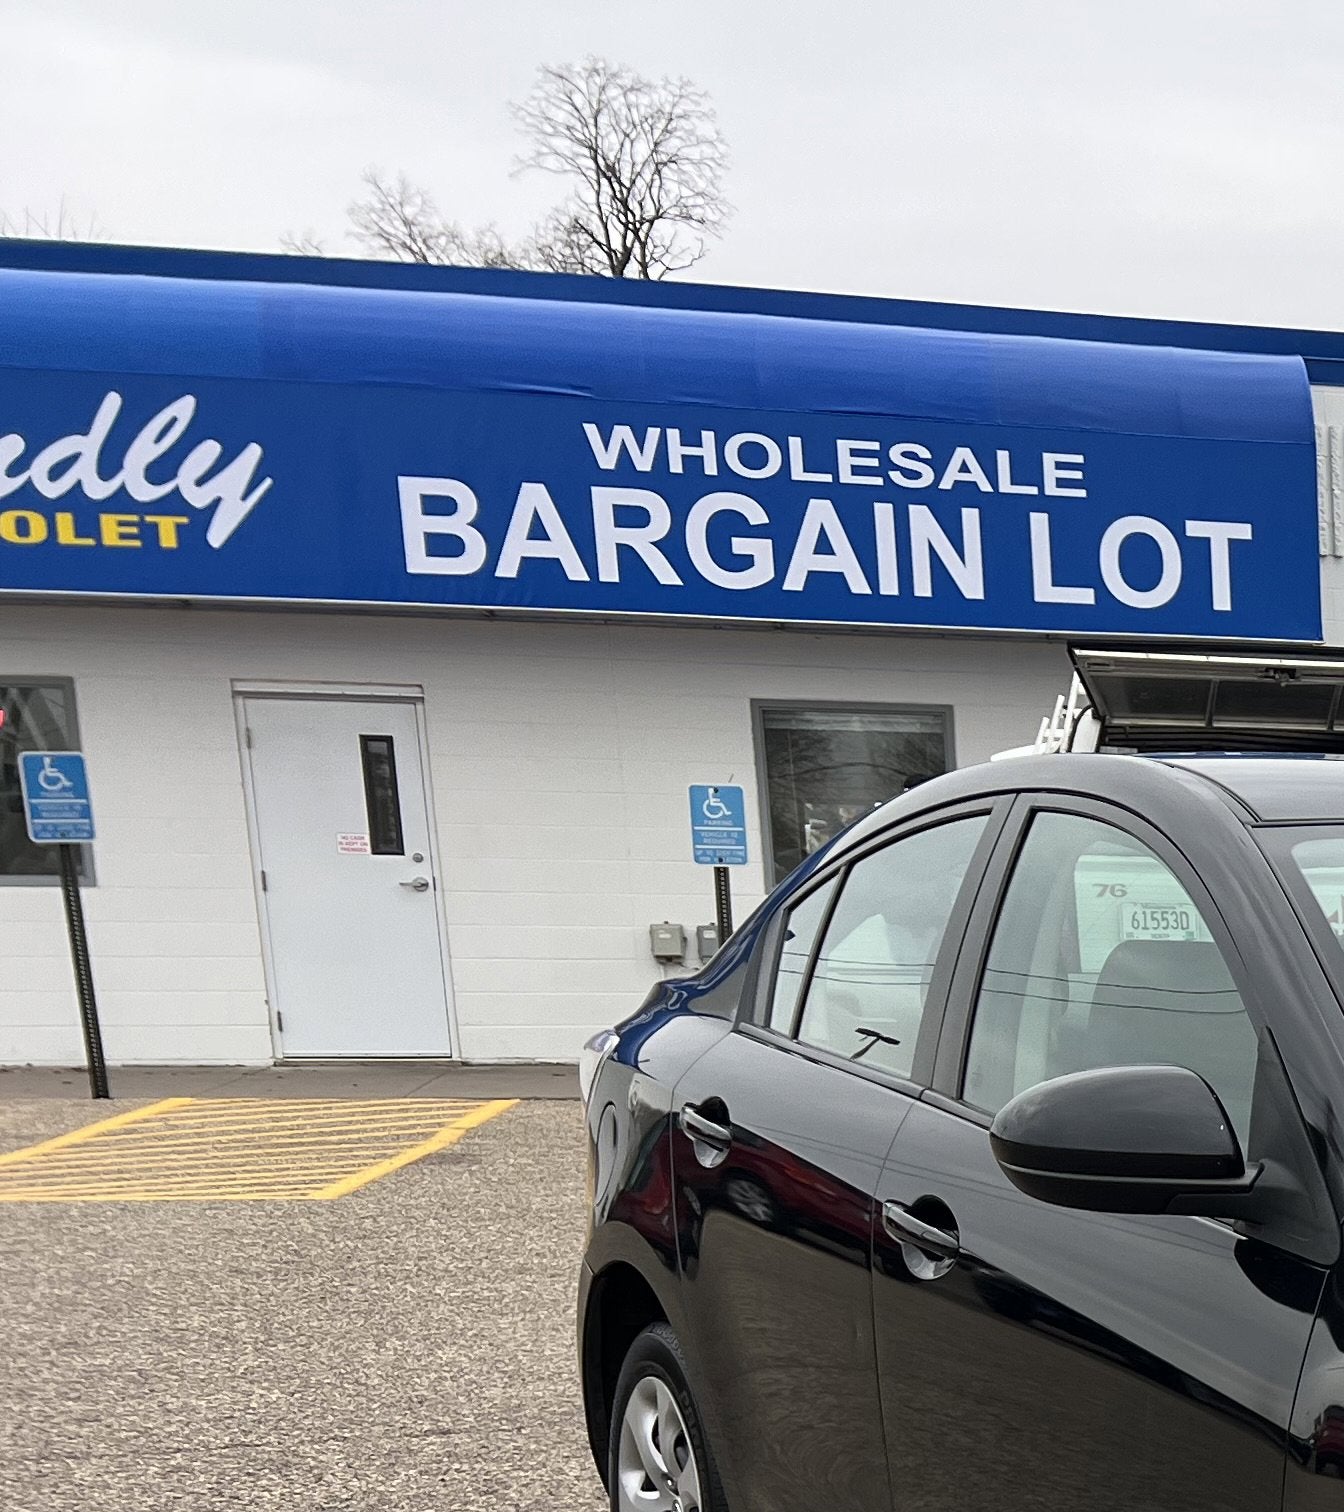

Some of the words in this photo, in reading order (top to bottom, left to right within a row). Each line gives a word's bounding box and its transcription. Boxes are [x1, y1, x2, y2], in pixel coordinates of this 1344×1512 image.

[583, 422, 1088, 499] WHOLESALE
[0, 509, 190, 549] OLET
[397, 475, 986, 602] BARGAIN
[1028, 511, 1253, 612] LOT
[1092, 883, 1128, 898] 76
